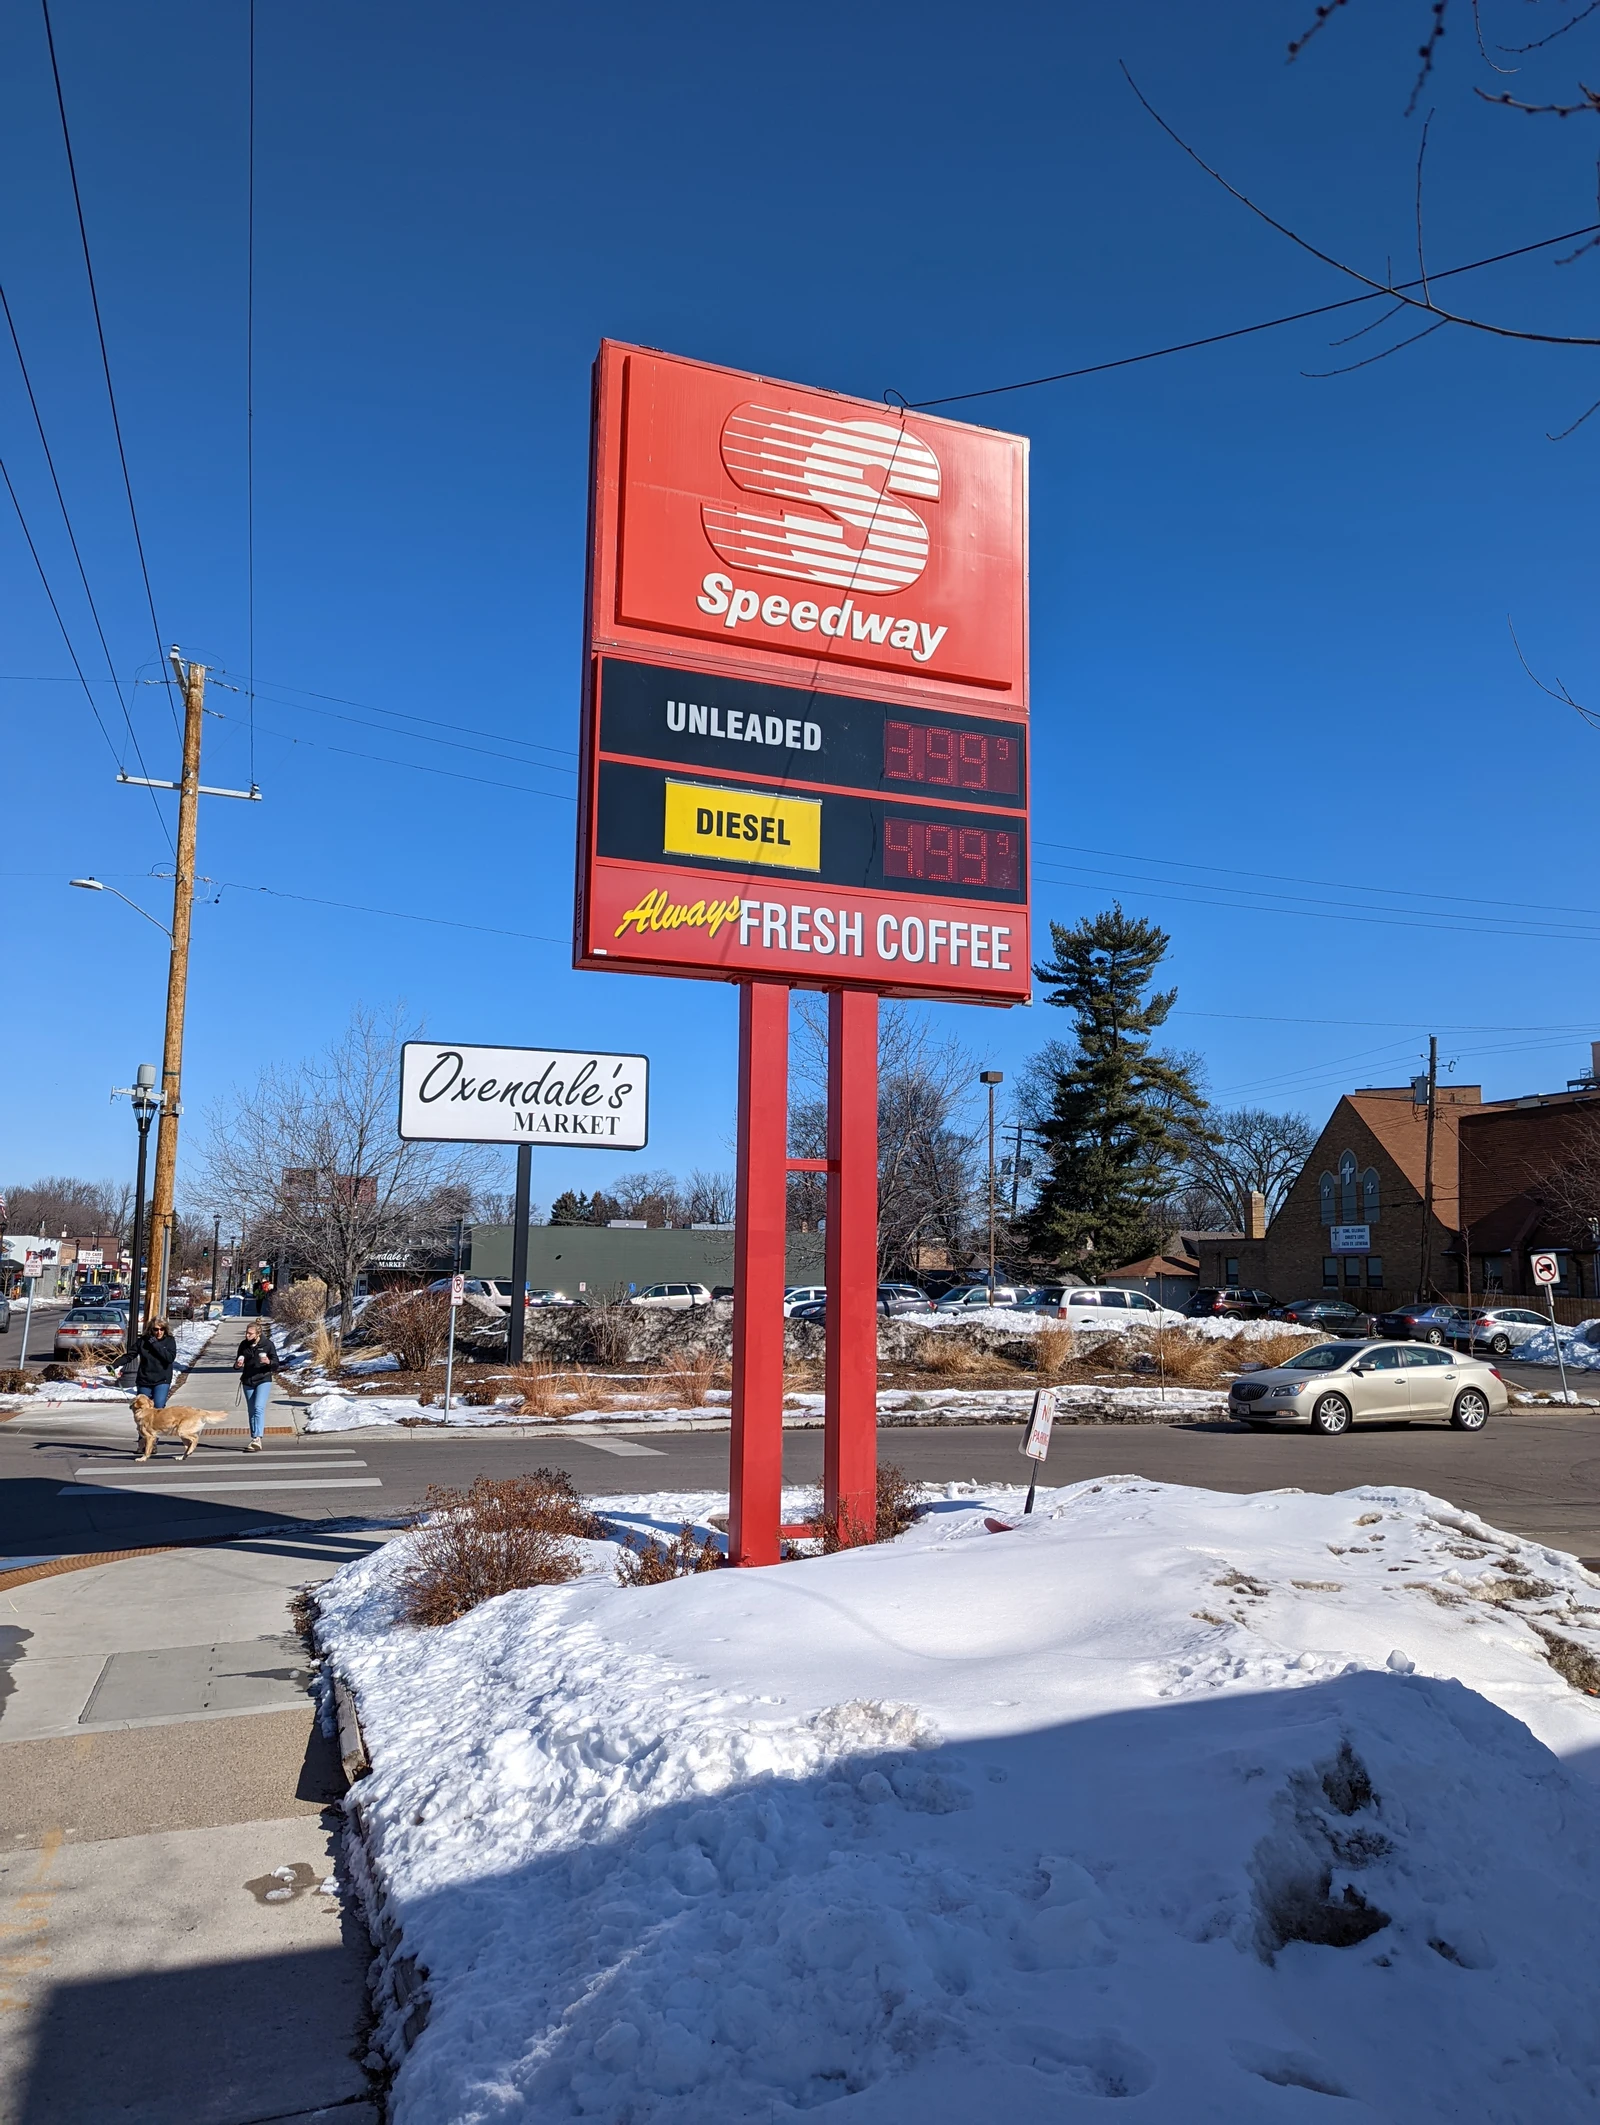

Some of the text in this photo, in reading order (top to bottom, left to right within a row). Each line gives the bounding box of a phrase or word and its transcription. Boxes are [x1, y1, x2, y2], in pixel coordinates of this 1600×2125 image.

[697, 573, 948, 661] Speedway
[666, 700, 822, 751] UNLEADED
[696, 807, 791, 846] DIESEL
[614, 888, 1012, 971] Always FRESH COFFEE
[418, 1051, 633, 1110] Oxendale's
[512, 1111, 621, 1136] MARKET
